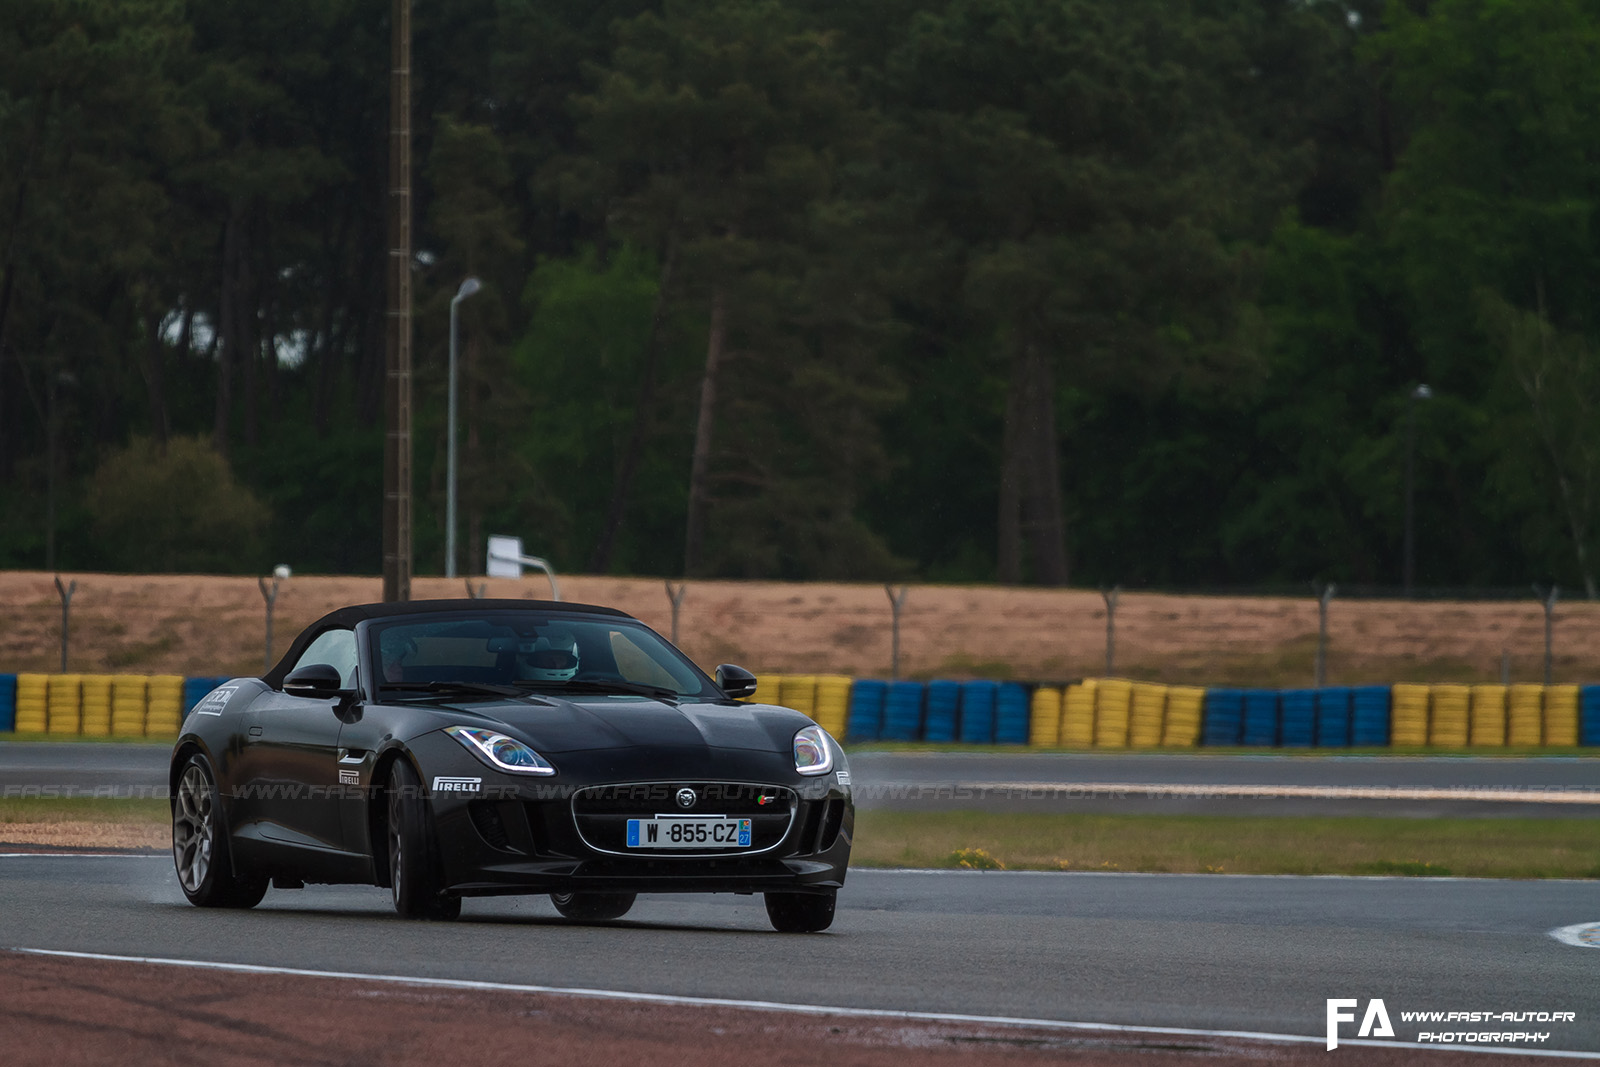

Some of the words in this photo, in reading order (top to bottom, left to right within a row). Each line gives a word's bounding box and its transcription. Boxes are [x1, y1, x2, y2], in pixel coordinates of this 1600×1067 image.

[338, 769, 360, 785] PIRELLI
[432, 776, 482, 792] PIRELLI
[739, 834, 749, 844] 27
